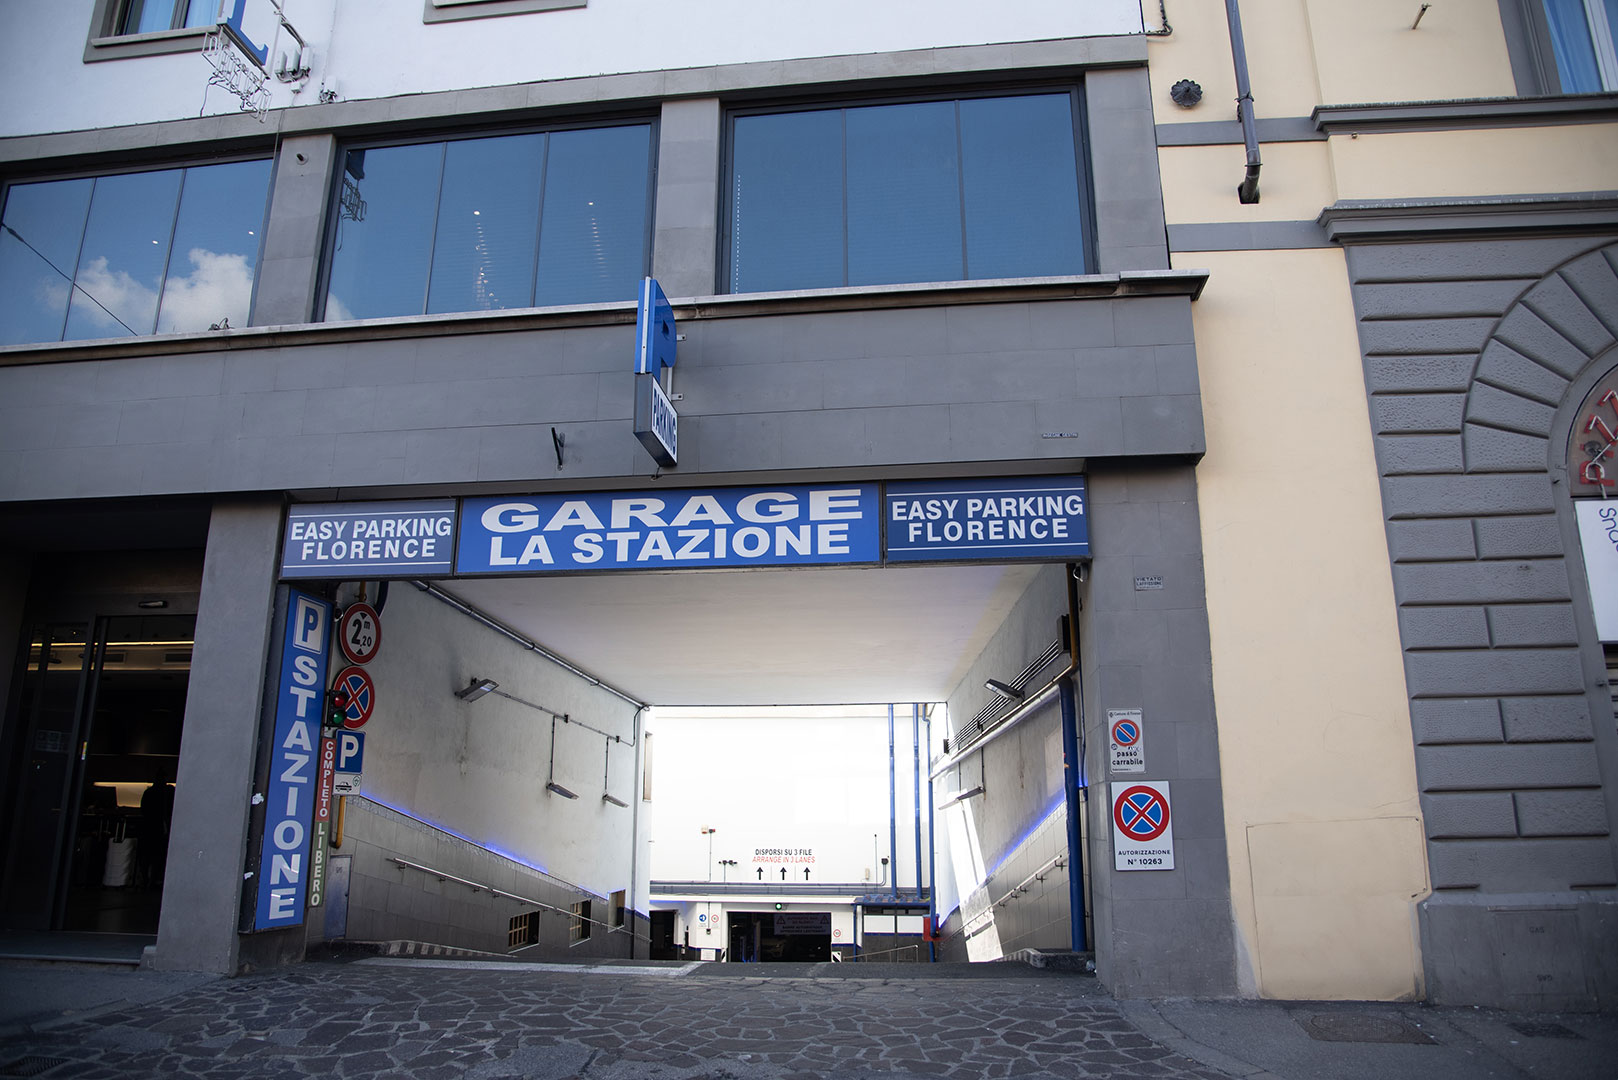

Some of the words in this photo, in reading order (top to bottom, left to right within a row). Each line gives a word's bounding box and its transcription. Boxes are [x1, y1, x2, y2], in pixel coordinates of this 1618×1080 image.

[653, 388, 677, 456] PARKING
[481, 489, 862, 532] GARAGE
[893, 500, 958, 520] EASY
[968, 496, 1083, 518] PARKING
[291, 521, 347, 541] EASY
[353, 517, 451, 539] PARKING
[302, 539, 436, 560] FLORENCE
[490, 535, 554, 565] LA
[572, 524, 849, 564] STAZIONE
[909, 518, 1068, 542] FLORENCE
[301, 605, 320, 648] P
[340, 735, 359, 769] P
[1112, 758, 1143, 766] carrabile
[270, 656, 317, 919] STAZIONE
[319, 741, 334, 817] COMPLETO
[311, 823, 325, 907] LIBERO
